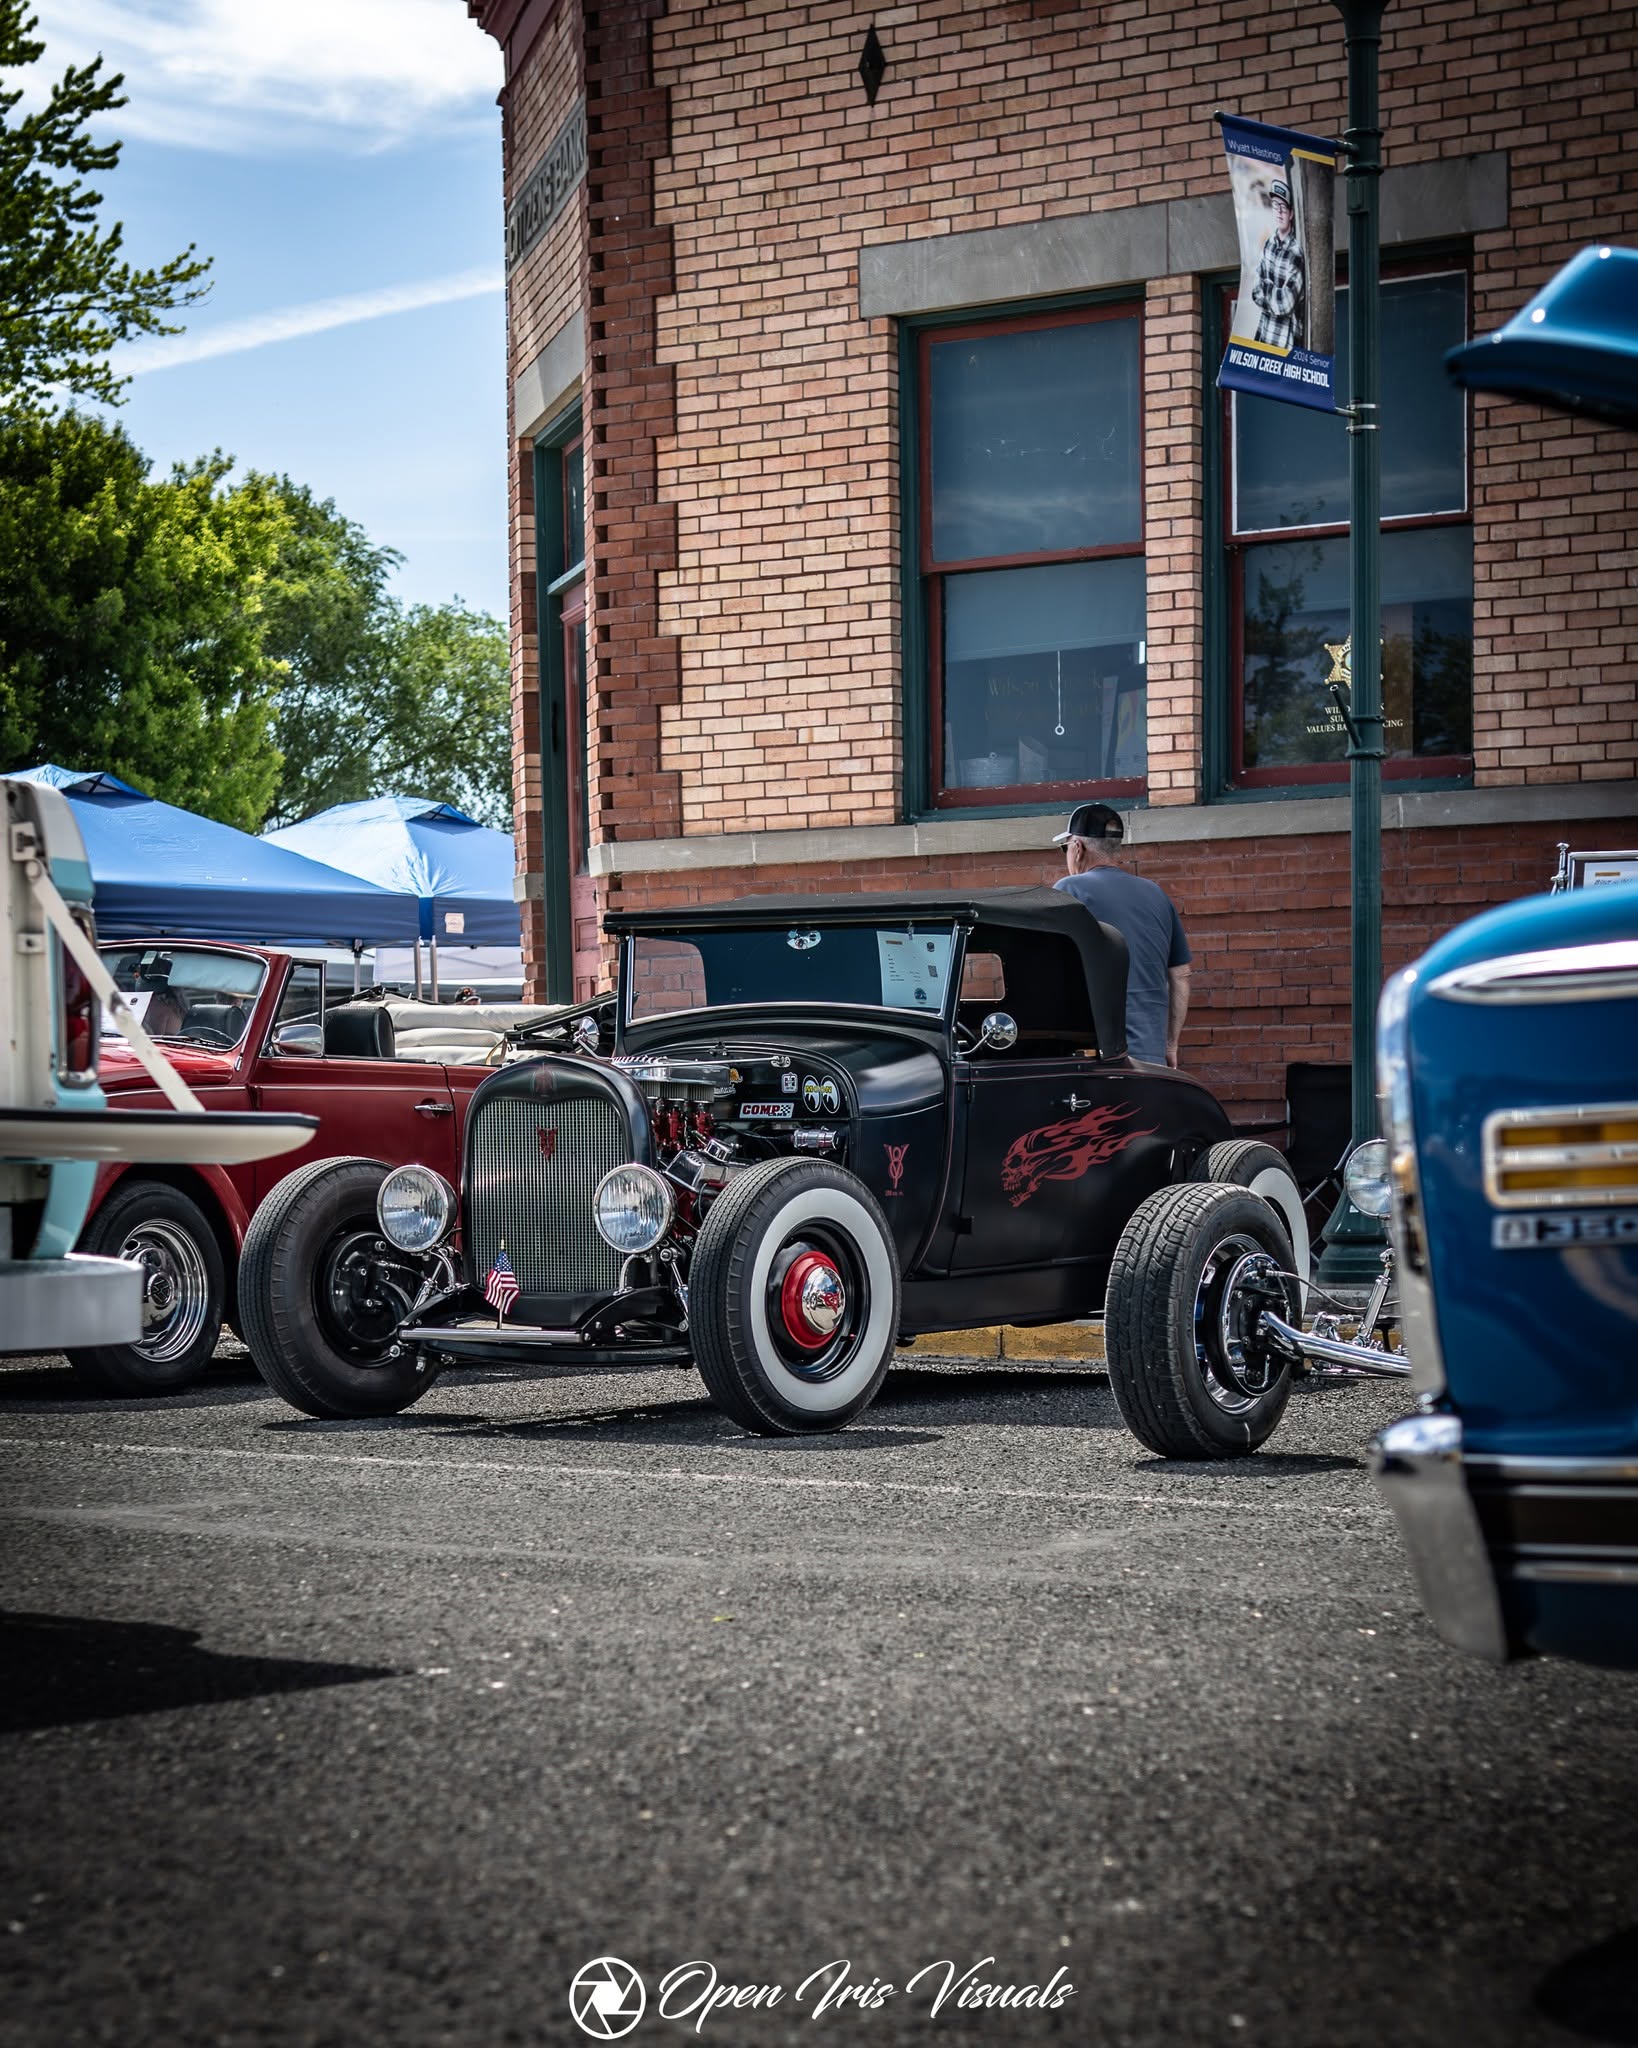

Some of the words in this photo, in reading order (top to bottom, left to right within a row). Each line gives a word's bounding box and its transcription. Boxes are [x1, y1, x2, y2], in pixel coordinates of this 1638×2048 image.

[555, 117, 585, 203] BANK
[1227, 139, 1250, 154] Wyatt
[1251, 146, 1283, 163] Hastings
[1293, 350, 1308, 362] 2024
[1309, 355, 1330, 368] Senior
[1229, 349, 1259, 369] WILSON
[1259, 358, 1282, 377] CREEK
[1283, 364, 1301, 381] HIGH
[1302, 368, 1330, 388] SCHOOL
[1306, 724, 1336, 734] VALUES
[805, 1085, 833, 1093] MOON
[742, 1104, 781, 1115] COMP
